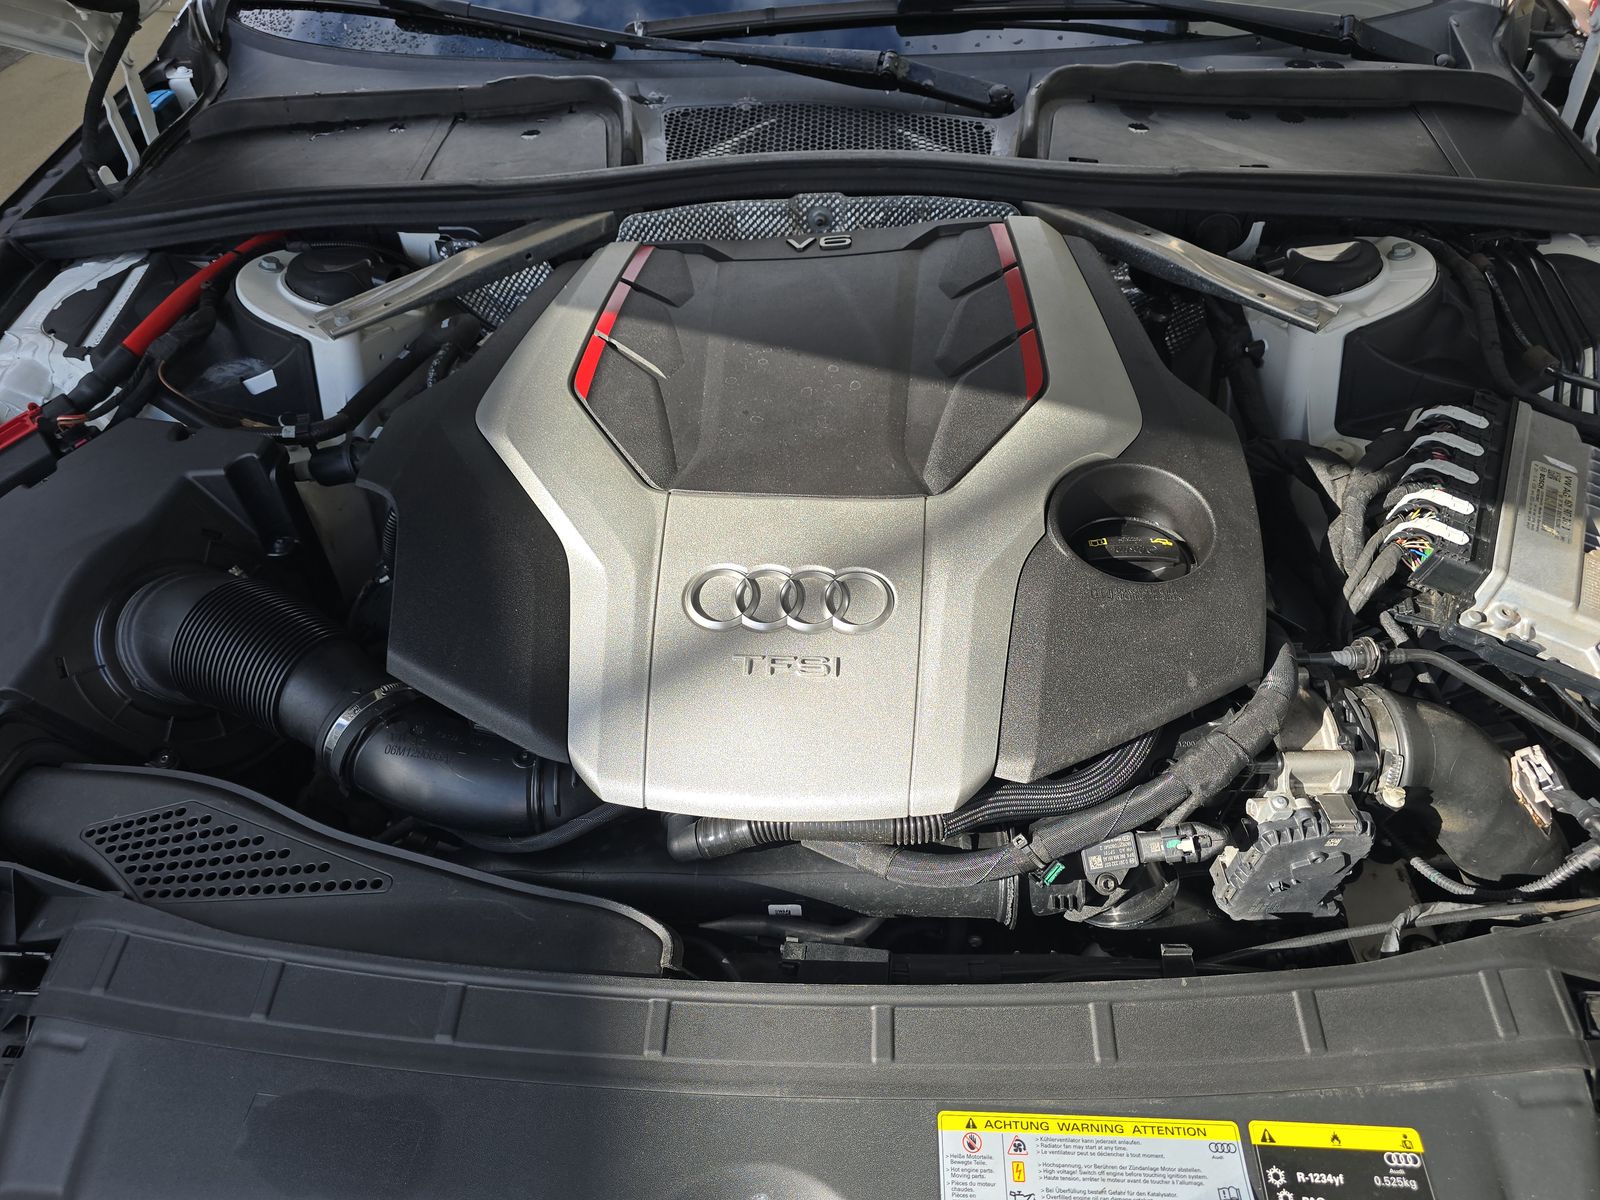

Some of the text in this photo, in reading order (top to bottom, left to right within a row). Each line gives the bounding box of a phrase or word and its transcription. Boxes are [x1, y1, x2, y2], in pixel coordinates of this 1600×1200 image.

[786, 235, 852, 252] V6
[732, 653, 842, 678] TFSI
[984, 1119, 1207, 1137] ACHTUNG WARNING ATTENTION
[1296, 1172, 1344, 1187] R-1234yf
[1373, 1175, 1418, 1190] 0.525kg
